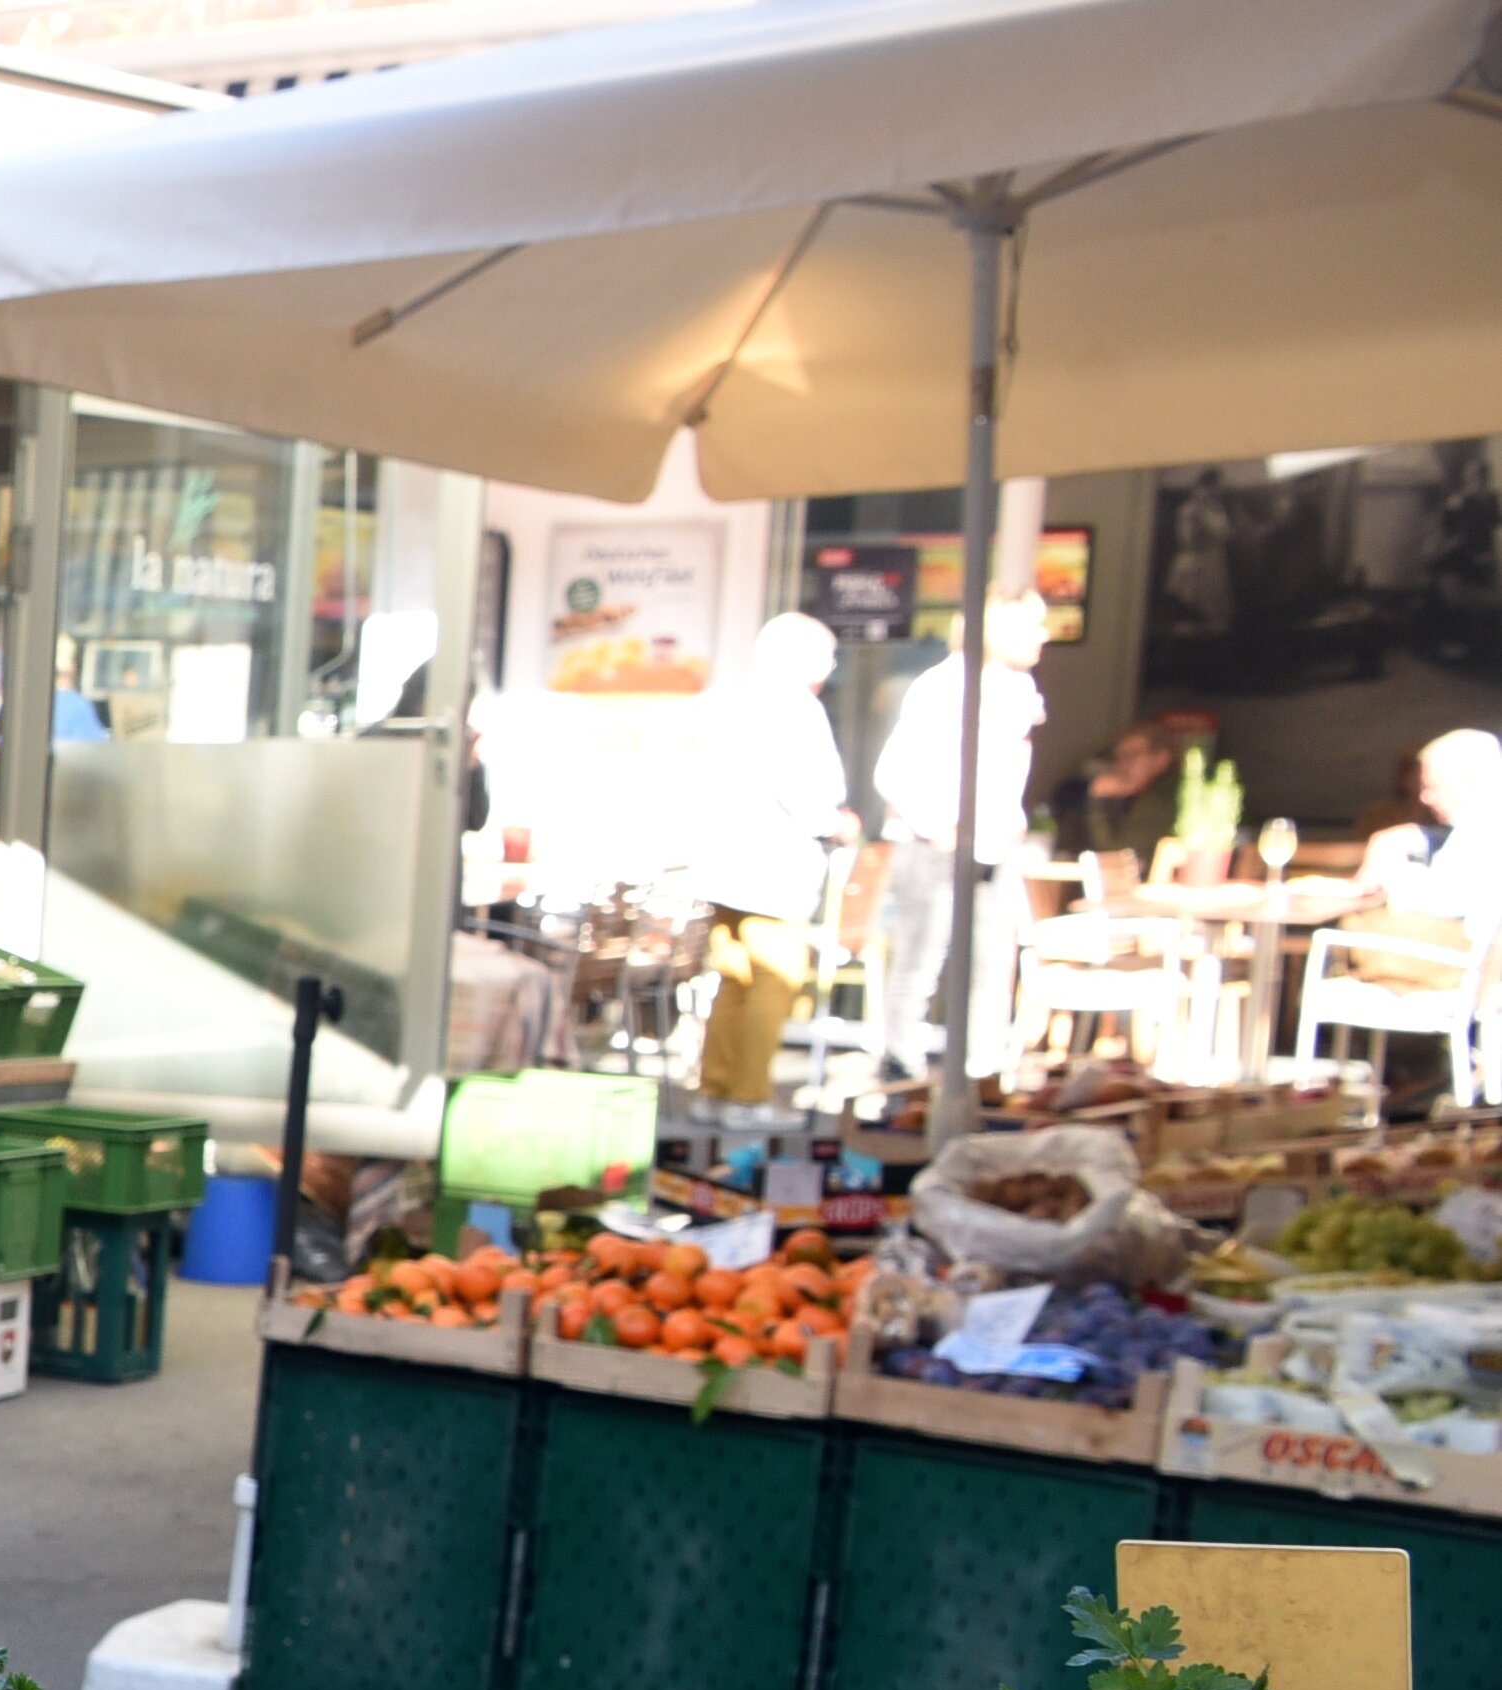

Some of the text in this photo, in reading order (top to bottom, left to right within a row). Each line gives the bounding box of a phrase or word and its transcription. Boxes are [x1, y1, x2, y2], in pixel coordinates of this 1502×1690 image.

[131, 534, 275, 602] la natura
[1263, 1430, 1394, 1478] OSCA
